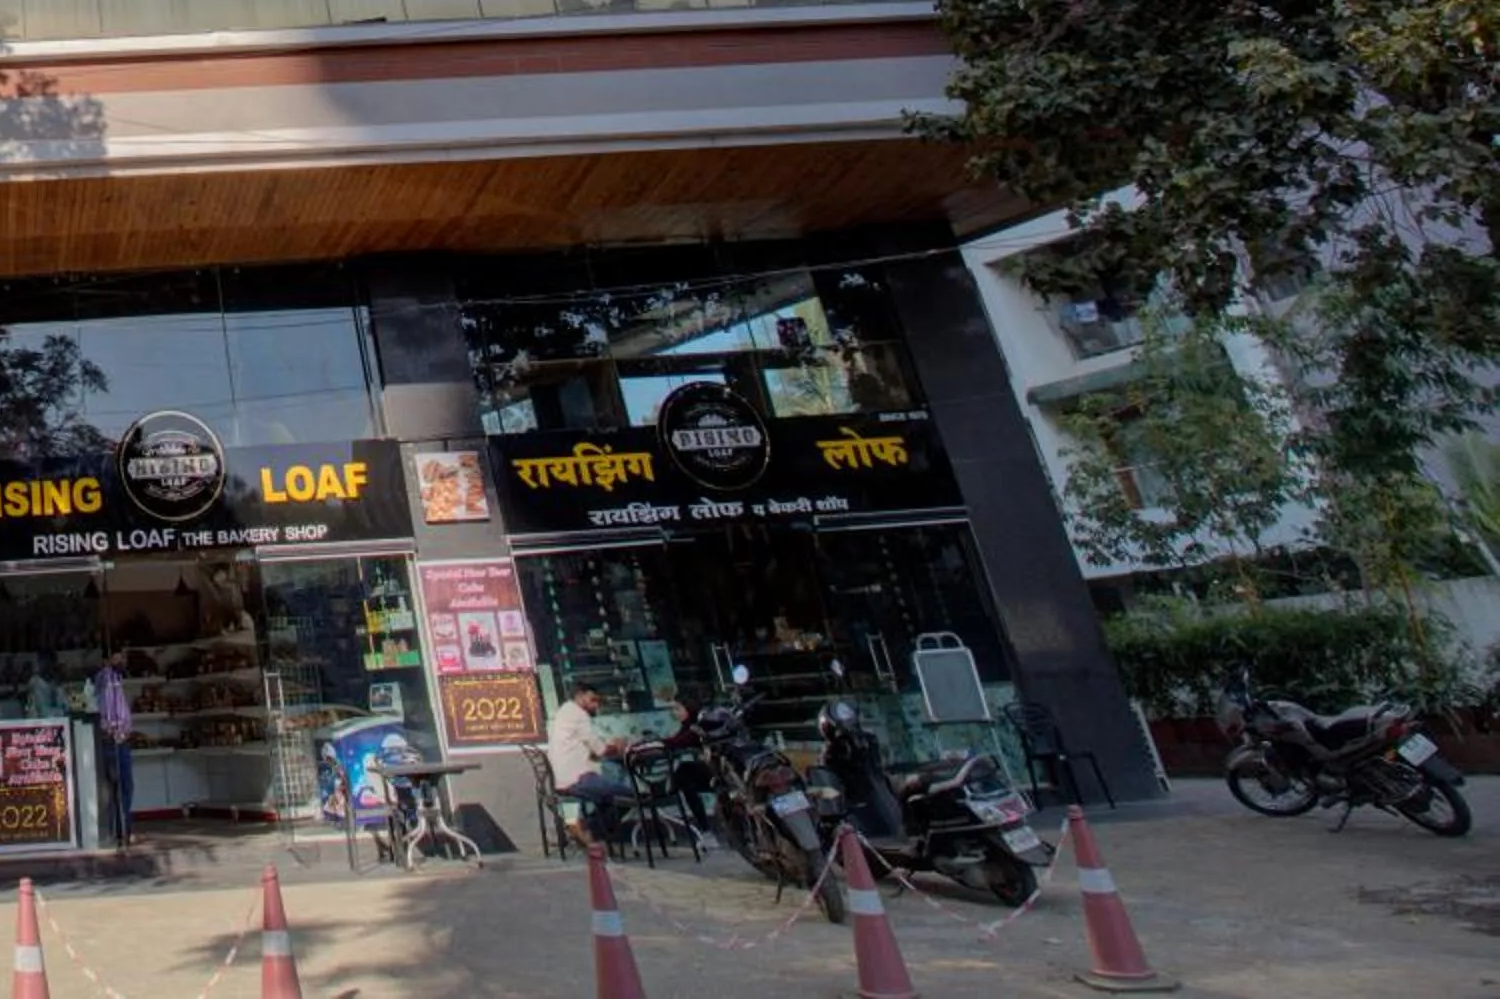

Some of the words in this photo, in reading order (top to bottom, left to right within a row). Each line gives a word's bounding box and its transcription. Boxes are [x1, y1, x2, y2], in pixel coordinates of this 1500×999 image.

[512, 444, 655, 492] रायझिंग
[816, 426, 910, 471] लोफ
[261, 462, 368, 503] LOAF
[688, 496, 744, 519] लोफ
[33, 530, 108, 555] RISING
[116, 528, 176, 550] LOAF
[182, 530, 214, 547] THE
[217, 527, 279, 545] BAKERY
[285, 523, 328, 540] SHOP
[463, 697, 523, 722] 2022
